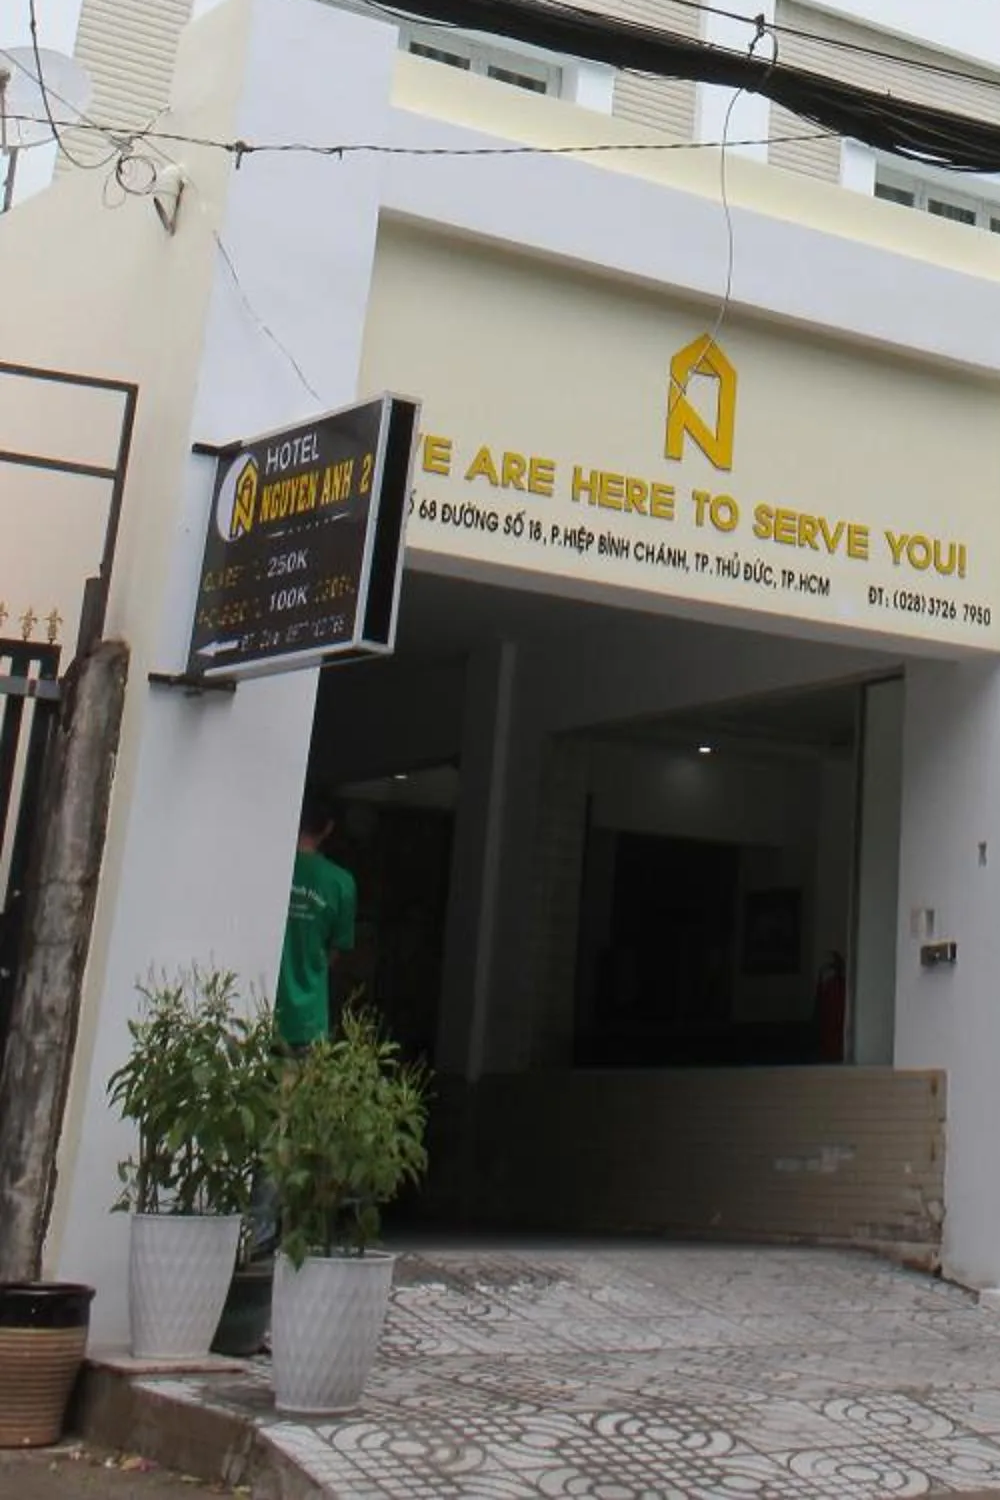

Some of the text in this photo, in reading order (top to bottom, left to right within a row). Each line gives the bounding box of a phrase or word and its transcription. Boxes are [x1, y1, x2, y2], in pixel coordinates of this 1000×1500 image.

[265, 431, 320, 476] HOTEL
[259, 469, 320, 524] NGUYEN
[320, 458, 354, 505] ANH
[359, 452, 373, 494] 2
[417, 433, 967, 579] E ARE HERE TO SERVE YOU!
[267, 548, 309, 578] 250K
[419, 499, 437, 520] 68
[503, 509, 526, 537] SỐ
[597, 530, 631, 560] BÌNH
[963, 602, 992, 626] 7950
[269, 584, 308, 612] 100K
